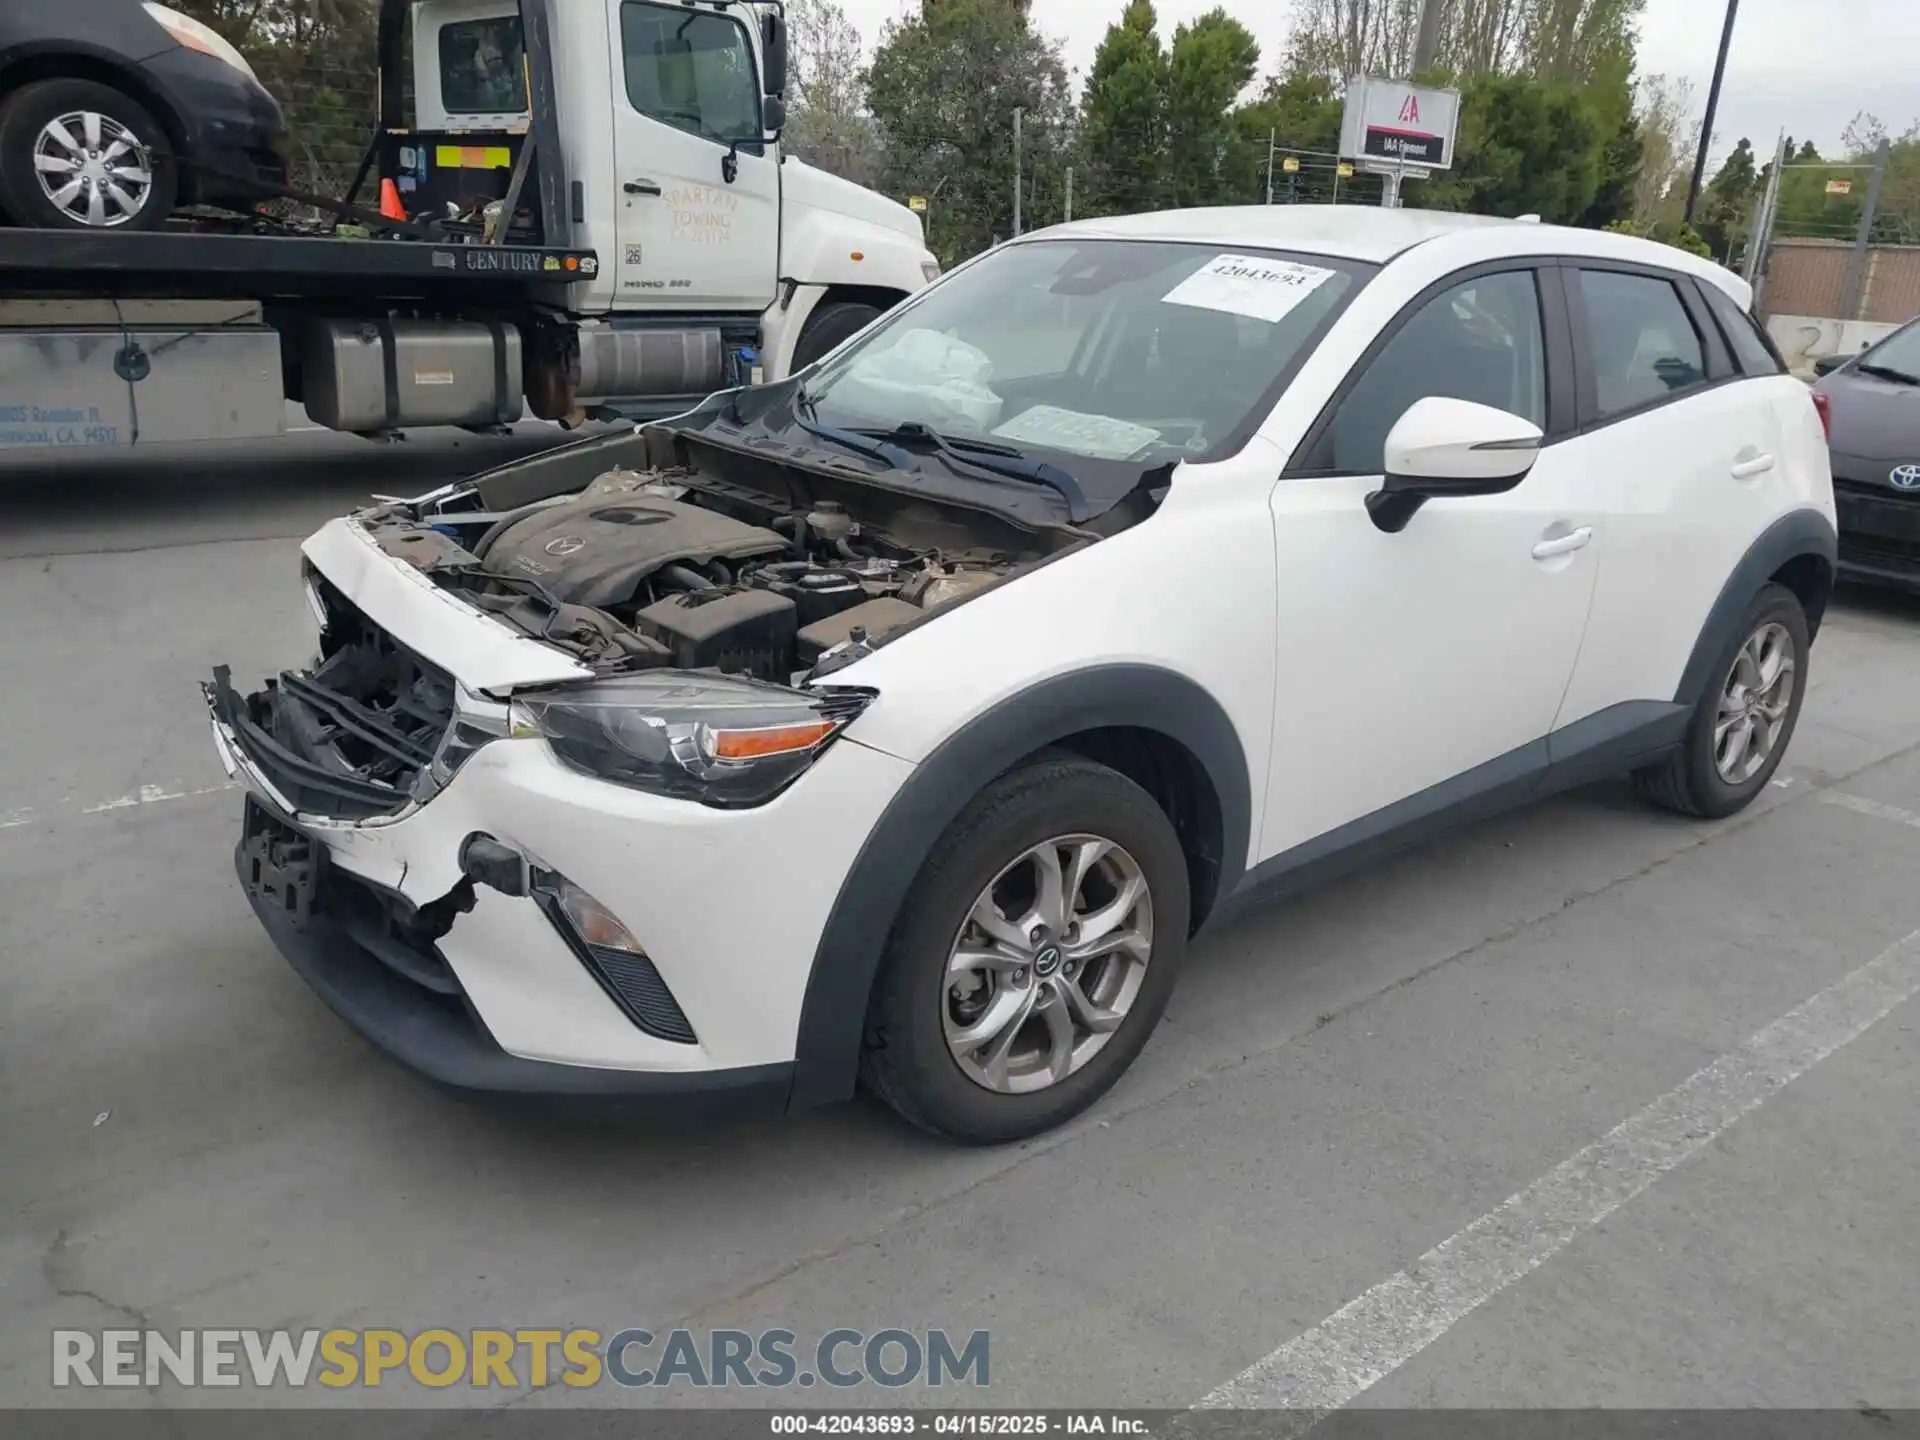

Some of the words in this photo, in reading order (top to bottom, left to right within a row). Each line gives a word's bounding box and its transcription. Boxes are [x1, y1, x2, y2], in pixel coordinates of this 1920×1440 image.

[662, 186, 738, 211] SPARTAN
[672, 210, 731, 228] TOWING
[466, 251, 542, 271] CENTURY
